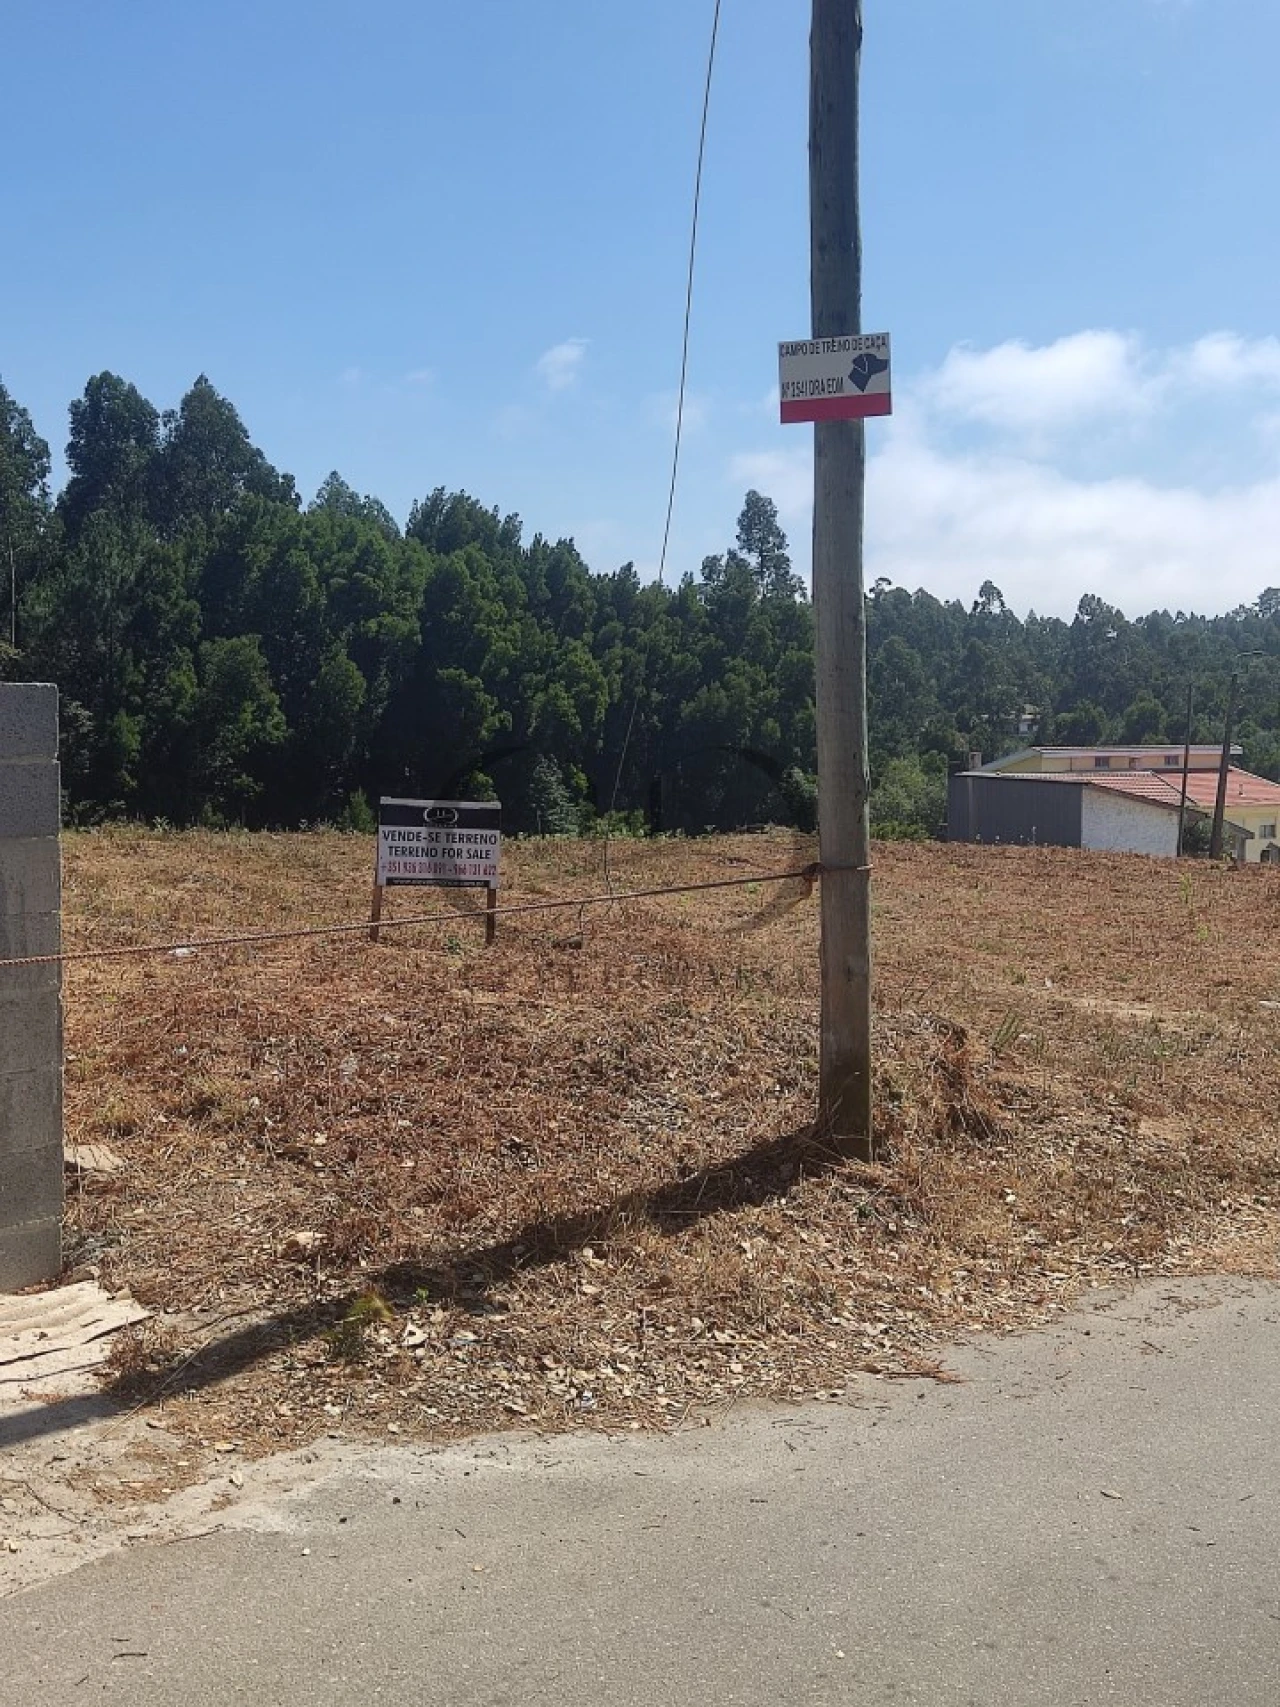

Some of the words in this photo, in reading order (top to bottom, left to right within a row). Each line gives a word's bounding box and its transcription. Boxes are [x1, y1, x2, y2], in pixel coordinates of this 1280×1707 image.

[780, 342, 808, 358] CAMPO
[809, 341, 821, 355] DE
[852, 338, 863, 352] DE
[864, 335, 888, 352] CAÇA
[382, 830, 442, 844] VENDE-SE
[445, 831, 498, 845] TERRENO
[387, 845, 438, 858] TERRENO
[442, 847, 463, 859] FOR
[466, 848, 492, 860] SALE
